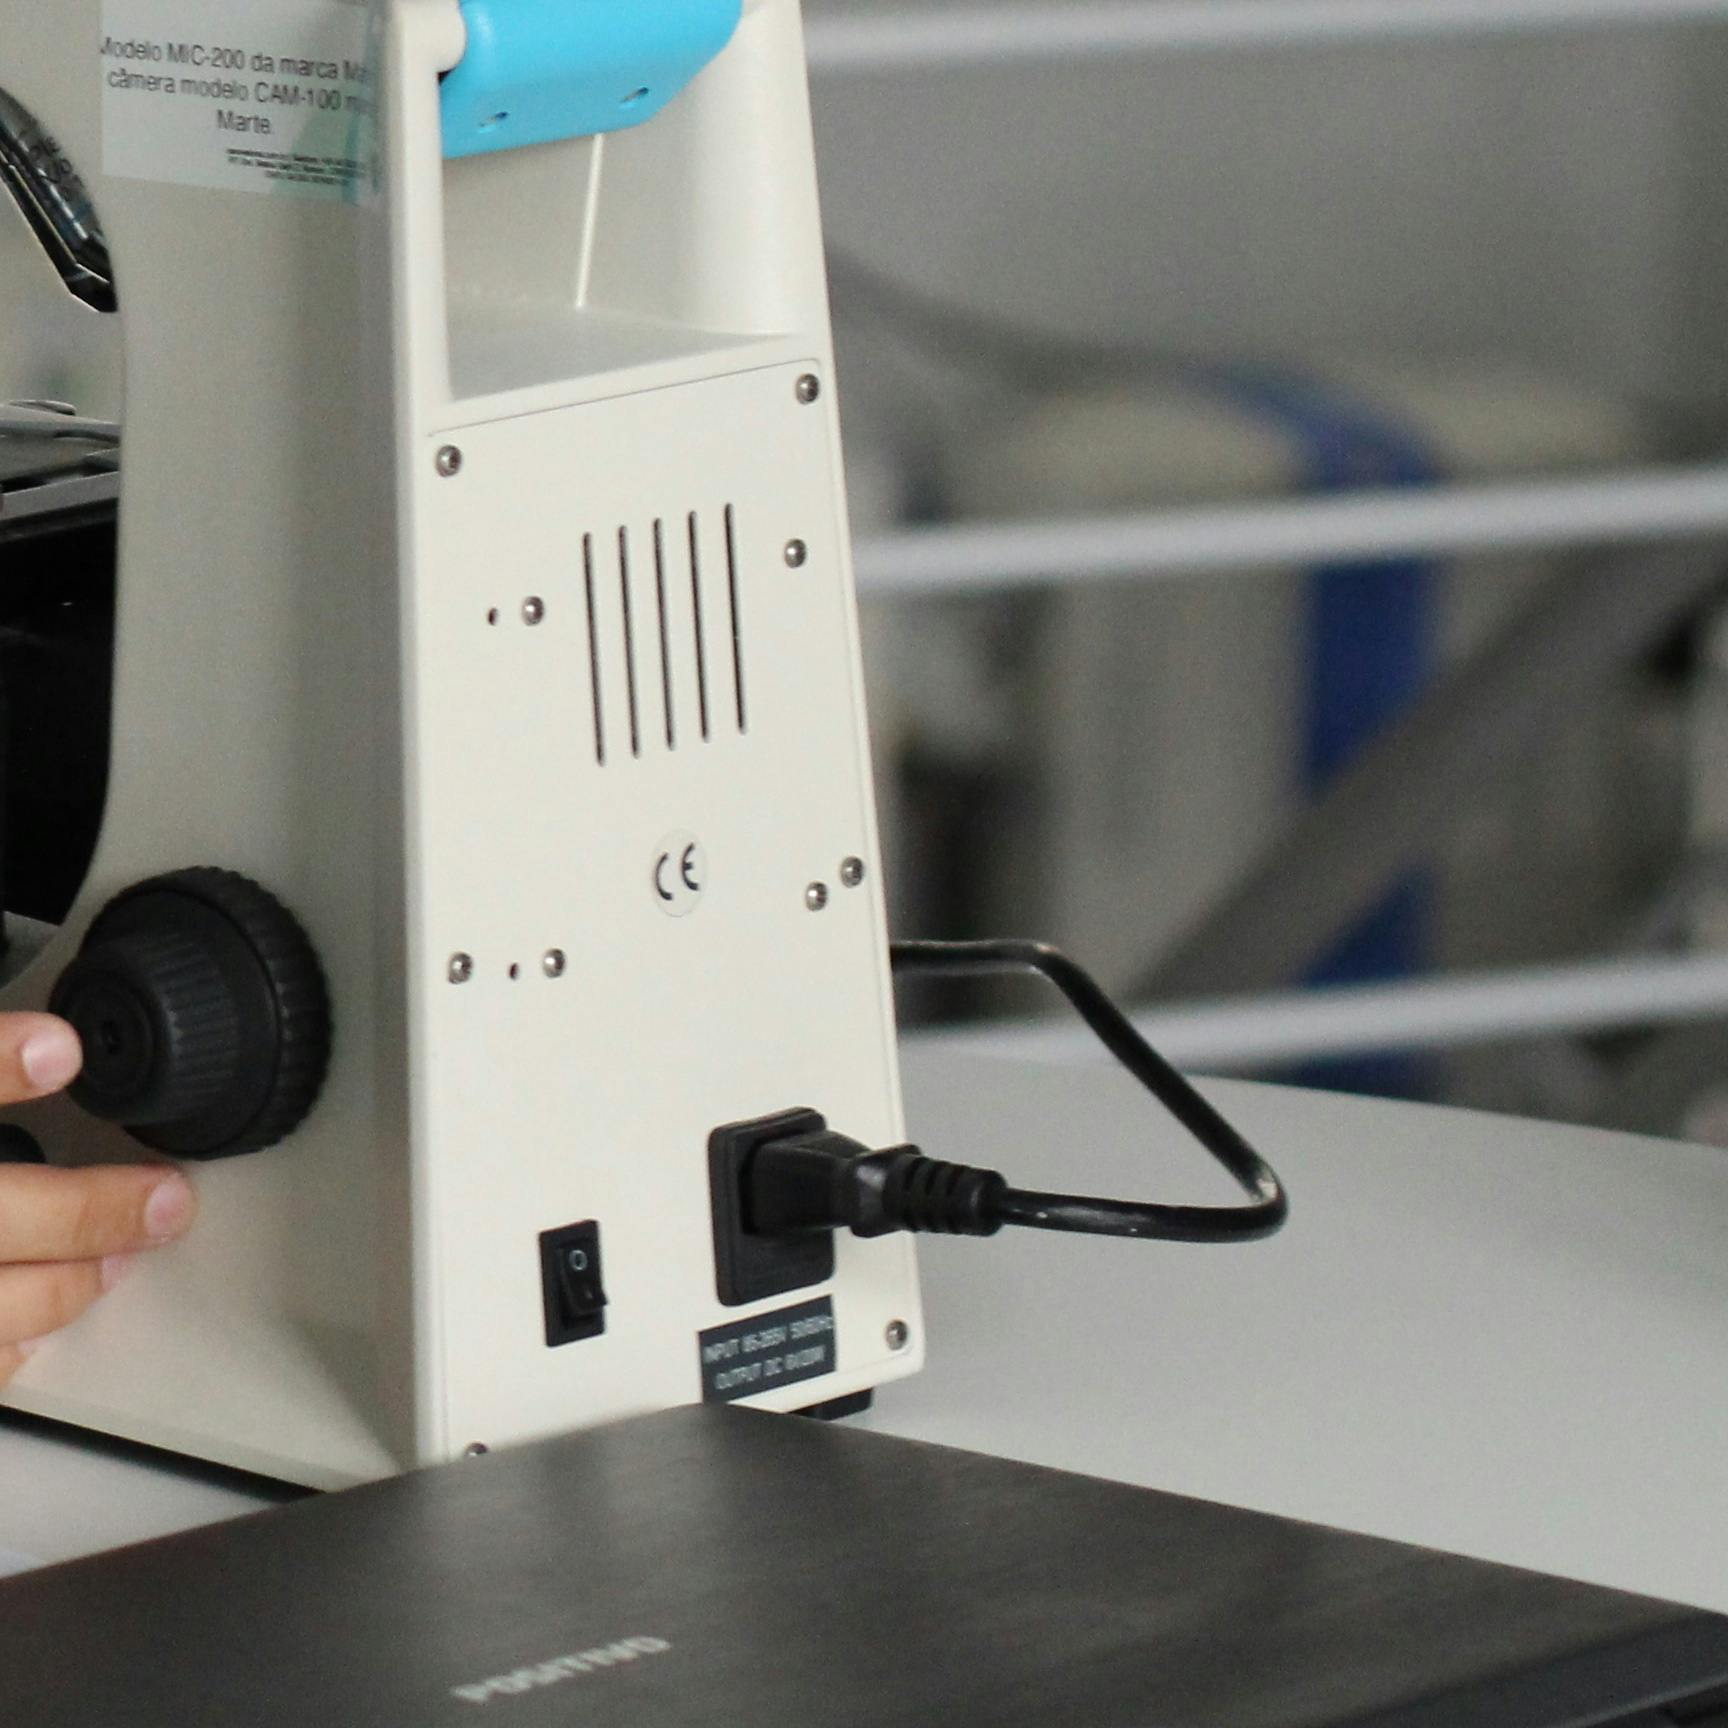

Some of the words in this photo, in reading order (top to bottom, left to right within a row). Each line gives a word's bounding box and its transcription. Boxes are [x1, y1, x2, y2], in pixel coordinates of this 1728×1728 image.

[167, 42, 246, 71] MIC-200
[250, 52, 274, 74] da
[279, 58, 339, 80] marca
[106, 67, 176, 94] câmera
[180, 76, 250, 102] modelo
[254, 81, 342, 111] CAM-100
[655, 842, 700, 901] CE
[714, 1362, 763, 1390] OUTPUT
